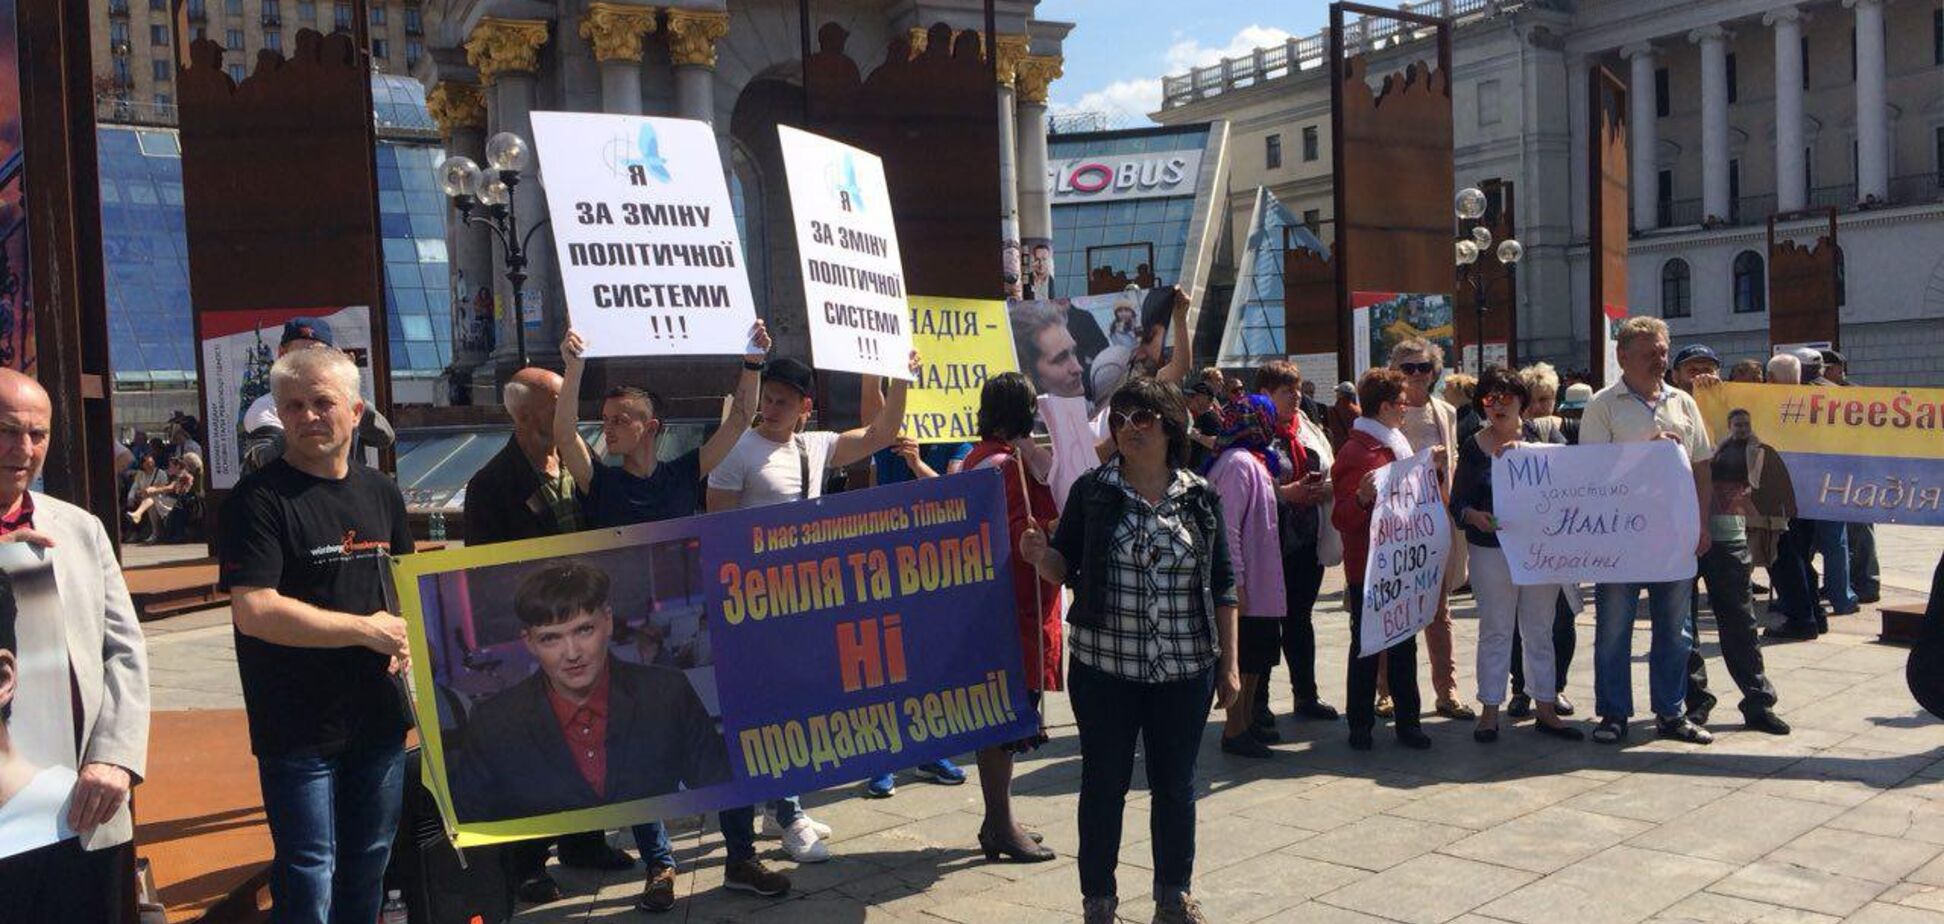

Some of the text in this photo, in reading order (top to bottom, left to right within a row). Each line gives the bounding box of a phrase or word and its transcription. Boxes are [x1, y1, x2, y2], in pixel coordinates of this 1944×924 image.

[628, 165, 647, 186] Я
[1048, 157, 1185, 193] LOBUS
[575, 202, 710, 228] ЗА ЗМІНУ
[840, 191, 851, 212] Я
[568, 241, 735, 268] ПОЛІТИЧНОЇ
[811, 220, 888, 258] ЗА ЗМІНУ
[593, 284, 731, 308] СИСТЕМИ
[808, 259, 902, 299] ПОЛІТИЧНОЇ
[824, 301, 900, 336] СИСТЕМИ
[900, 406, 981, 438] УКРАЇ
[1507, 454, 1552, 490] МИ
[1819, 472, 1940, 512] Надія
[753, 526, 764, 554] В
[802, 506, 909, 545] залишились
[913, 497, 967, 528] тільки
[1374, 513, 1434, 546] ВЧЕНКО
[719, 521, 995, 625] Земля та воля!
[835, 613, 907, 693] Ні
[738, 669, 1017, 779] продажу землі!
